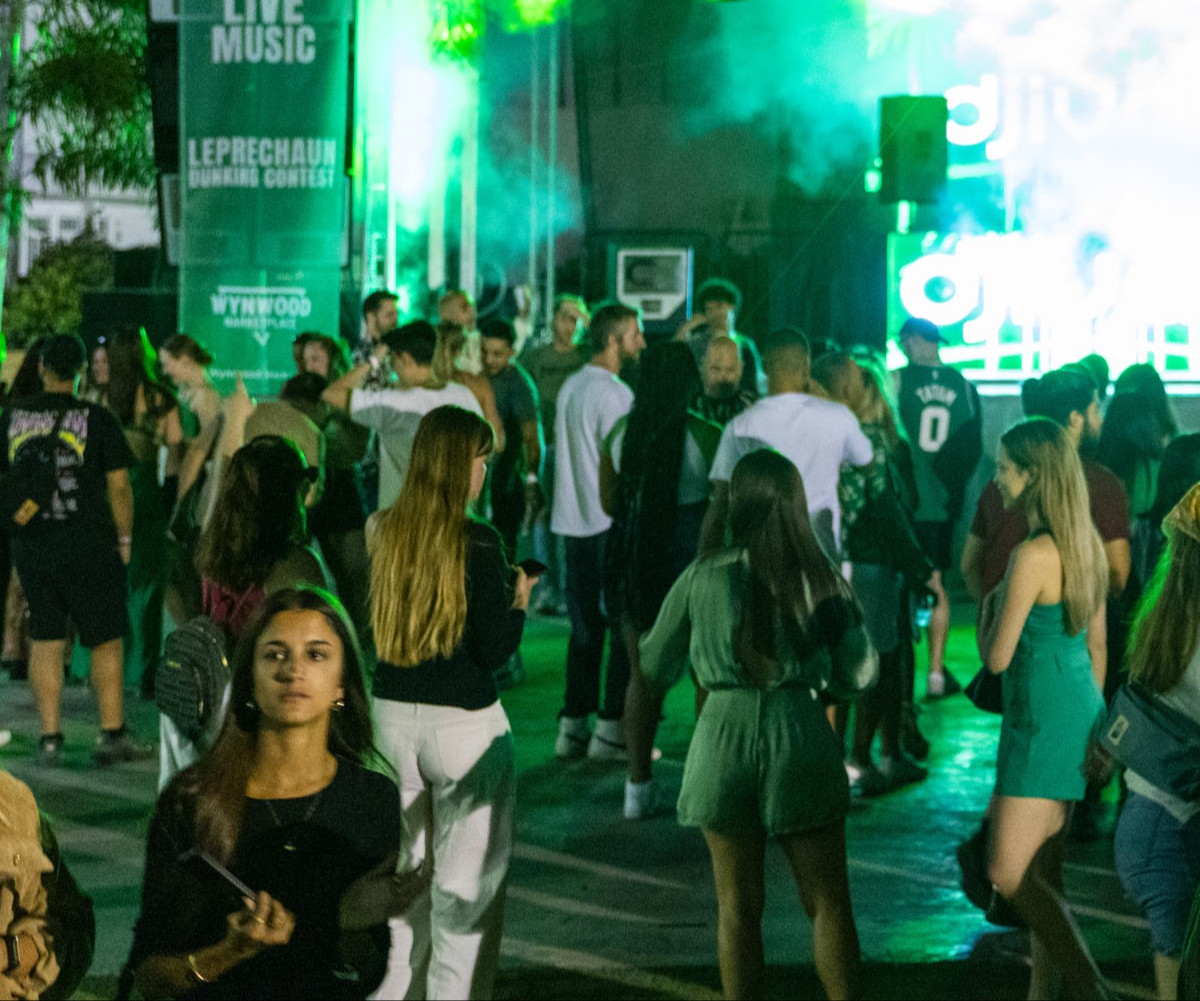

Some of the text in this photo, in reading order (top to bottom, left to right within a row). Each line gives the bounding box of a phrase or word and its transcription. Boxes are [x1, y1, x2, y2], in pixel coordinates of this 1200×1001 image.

[211, 24, 316, 65] MUSIC
[188, 136, 336, 168] LEPRECHAUN
[263, 168, 335, 189] CONTEST
[210, 293, 312, 318] WYNWOOD
[919, 405, 951, 453] 0
